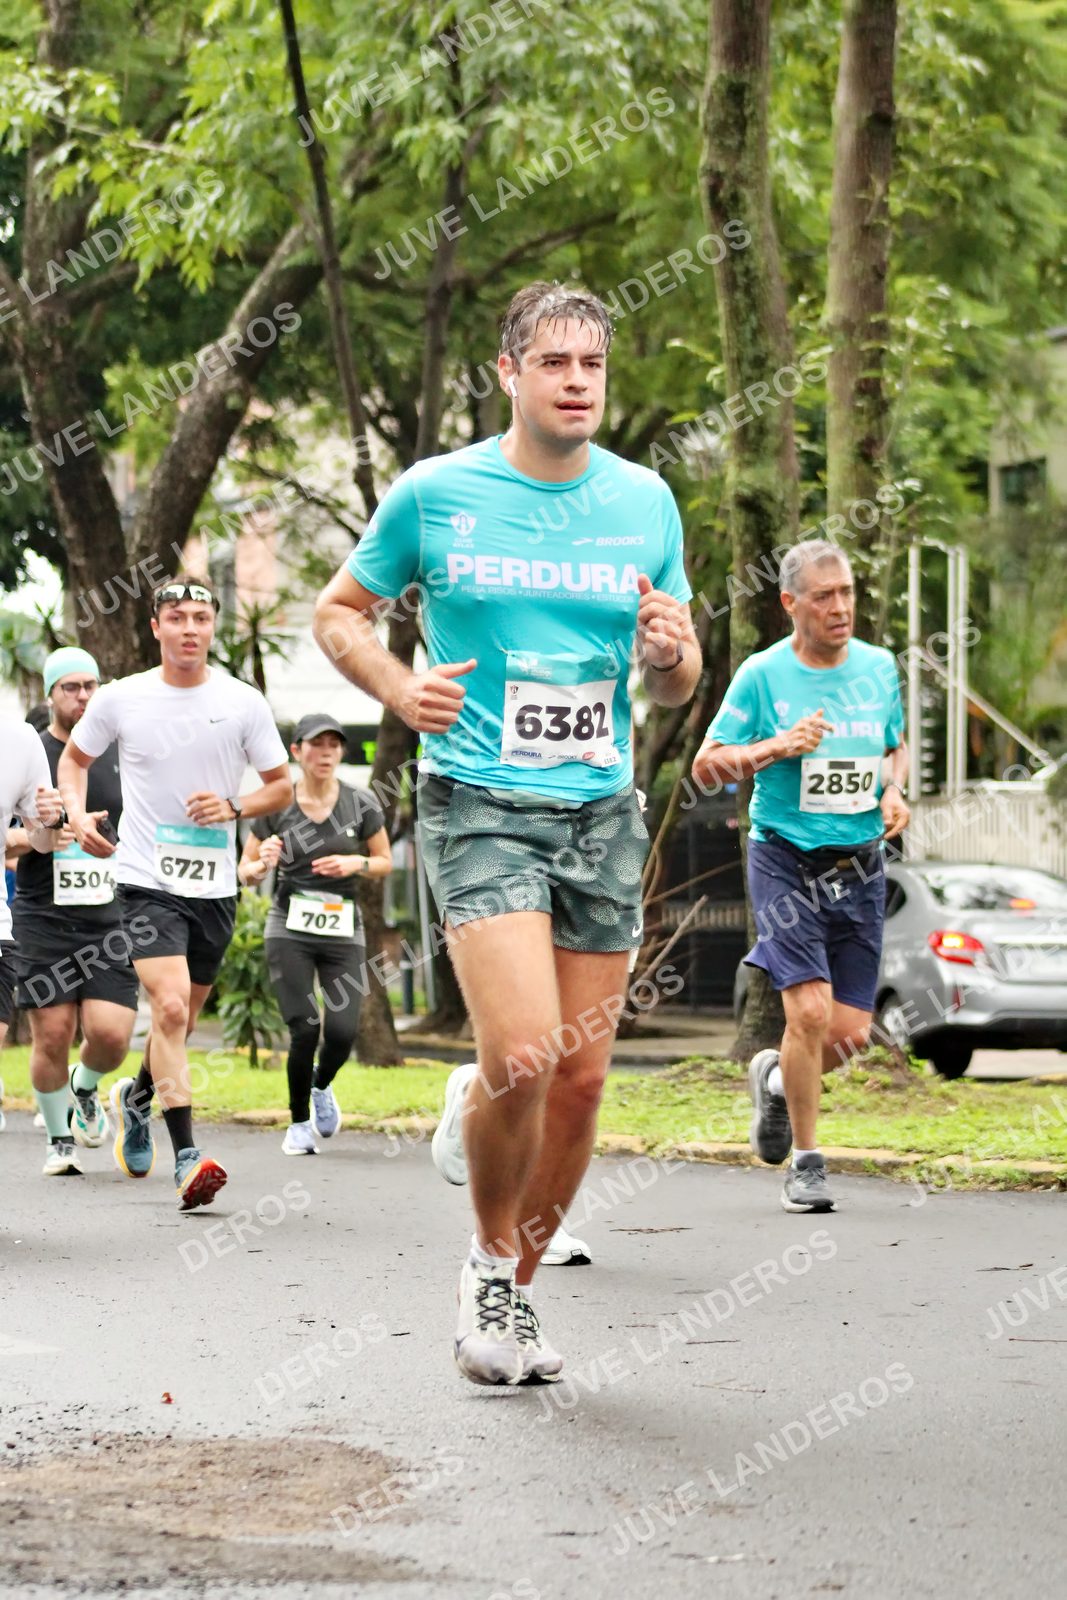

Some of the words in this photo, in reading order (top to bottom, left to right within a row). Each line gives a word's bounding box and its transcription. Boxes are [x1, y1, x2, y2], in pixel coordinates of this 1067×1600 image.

[595, 535, 645, 546] BROOKS
[447, 553, 640, 594] PERDURA
[523, 589, 591, 600] JUNTEADORES
[515, 702, 609, 740] 6382
[511, 750, 542, 758] PERDURA
[808, 771, 873, 795] 2850
[160, 857, 216, 881] 6721
[59, 871, 115, 888] 5304
[302, 911, 340, 930] 702
